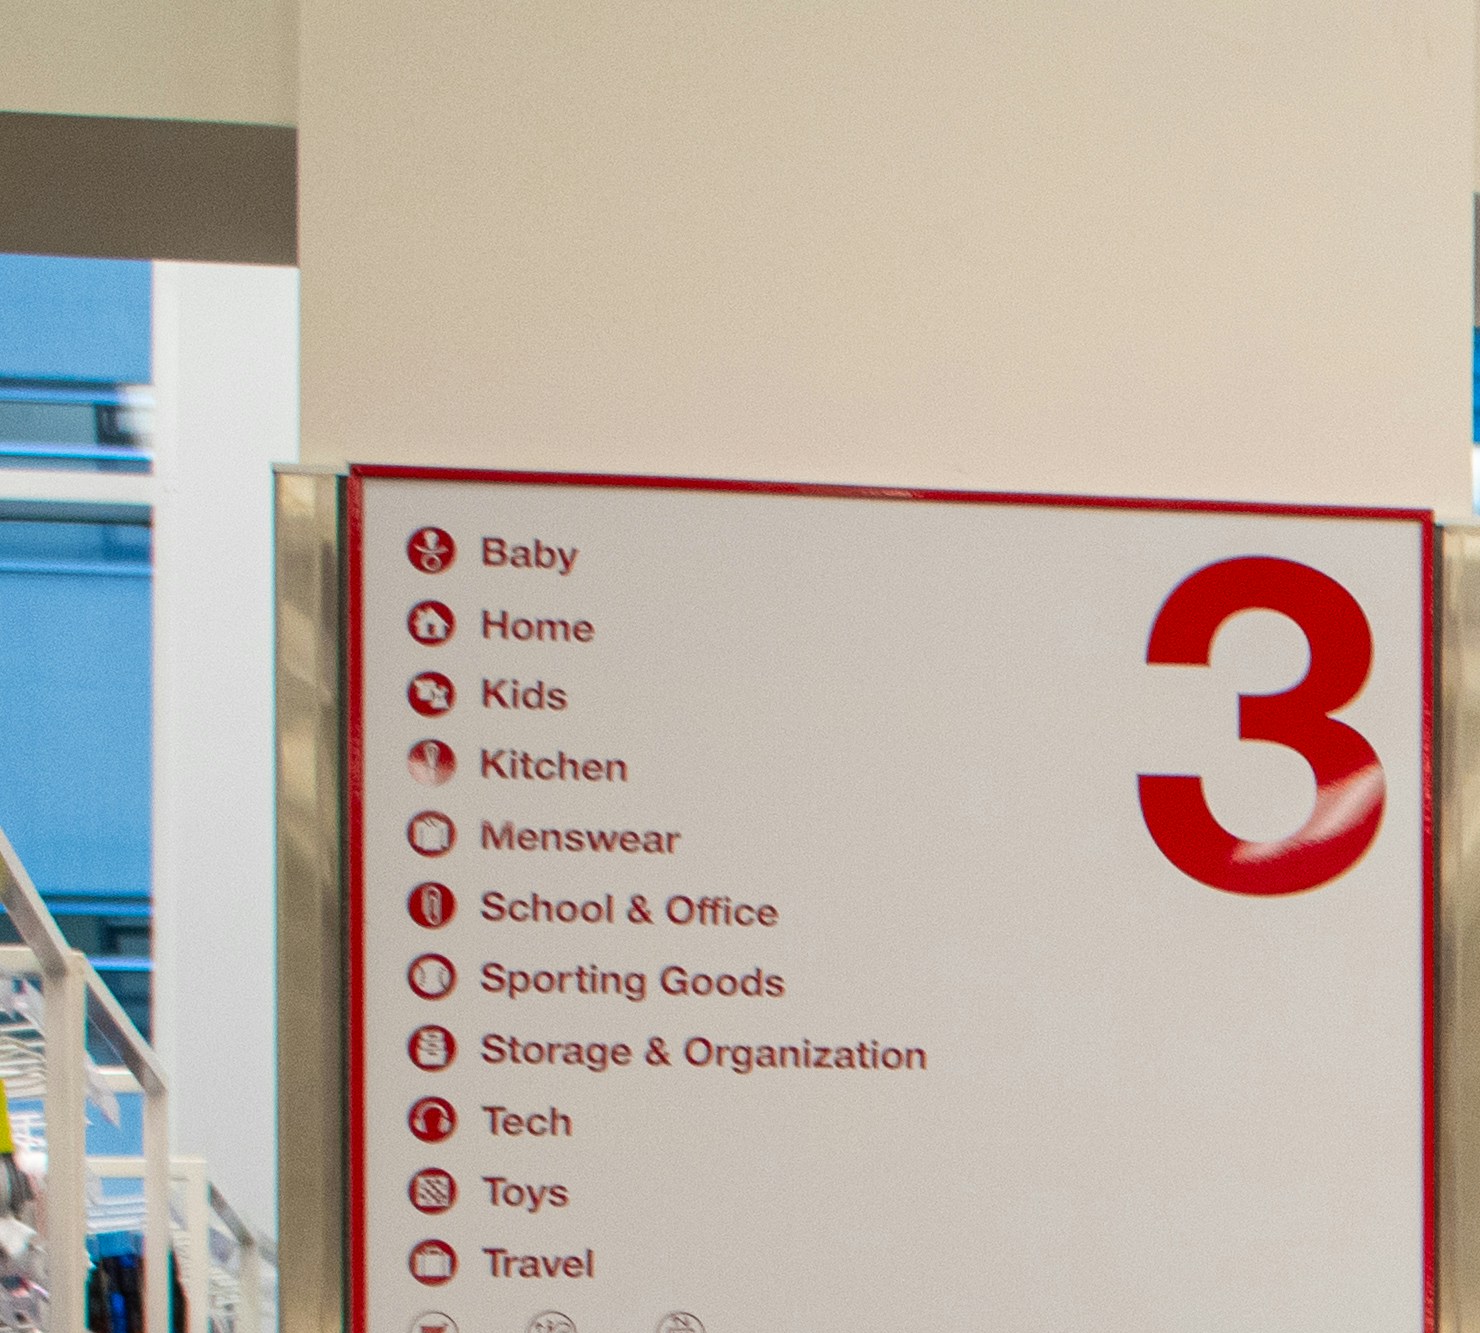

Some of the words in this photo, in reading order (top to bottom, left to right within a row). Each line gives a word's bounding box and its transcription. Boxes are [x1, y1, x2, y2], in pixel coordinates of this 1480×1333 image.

[481, 537, 579, 575] Baby
[481, 610, 595, 643] Home
[481, 679, 568, 711] Kids
[1138, 555, 1387, 897] 3
[481, 749, 629, 783] Kitchen
[481, 821, 681, 854] Menswear
[481, 891, 614, 925] School
[627, 895, 654, 924] &
[666, 895, 779, 927] Office
[481, 963, 647, 1001] Sporting
[660, 965, 785, 998] Goods
[481, 1034, 632, 1072] Storage
[646, 1037, 672, 1068] &
[685, 1037, 927, 1074] Organization
[483, 1106, 572, 1137] Tech
[483, 1176, 569, 1215] Toys
[482, 1248, 595, 1281] Travel
